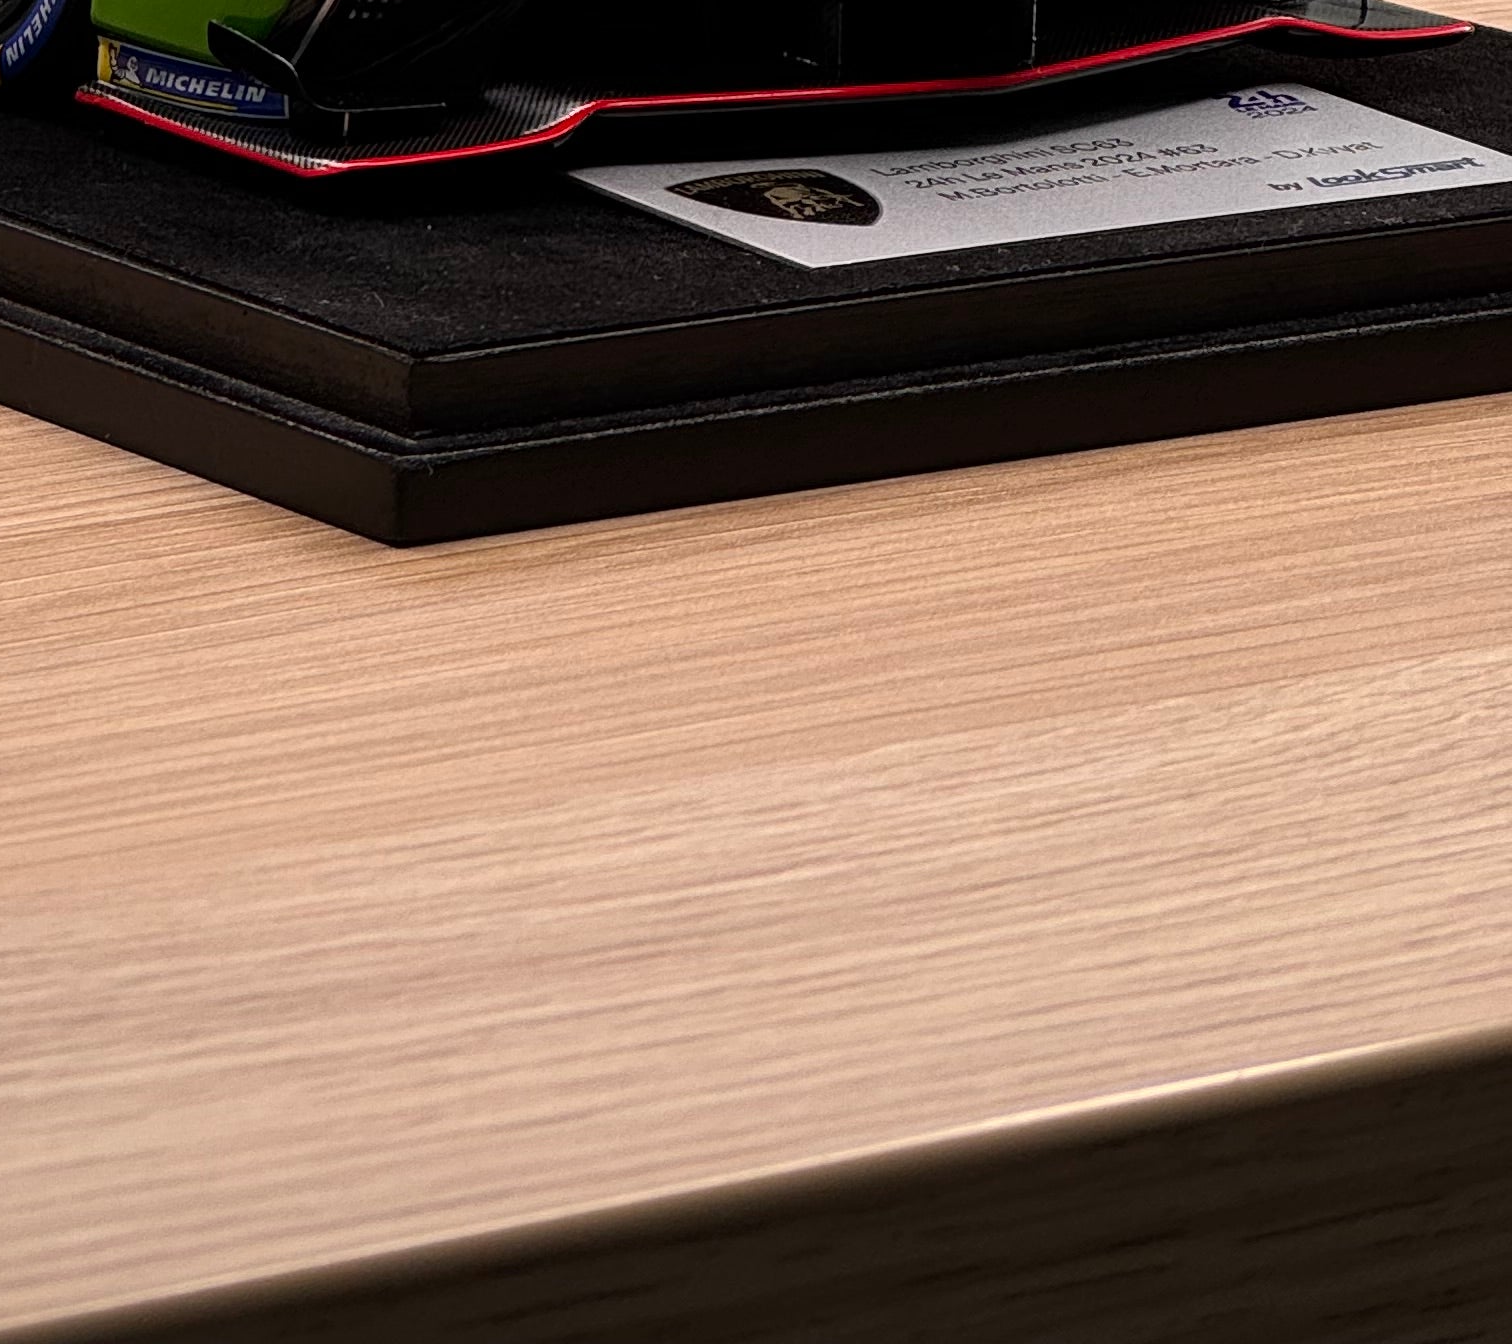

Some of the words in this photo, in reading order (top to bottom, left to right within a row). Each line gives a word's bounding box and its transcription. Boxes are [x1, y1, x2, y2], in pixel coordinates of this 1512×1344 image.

[145, 68, 267, 103] MICHELIN
[870, 146, 1054, 177] Lamborghini
[905, 176, 963, 189] 24h
[961, 171, 1004, 182] Le
[1001, 161, 1083, 178] Mans
[1080, 152, 1157, 167] 2024
[1157, 144, 1218, 158] #63
[1267, 181, 1304, 192] by
